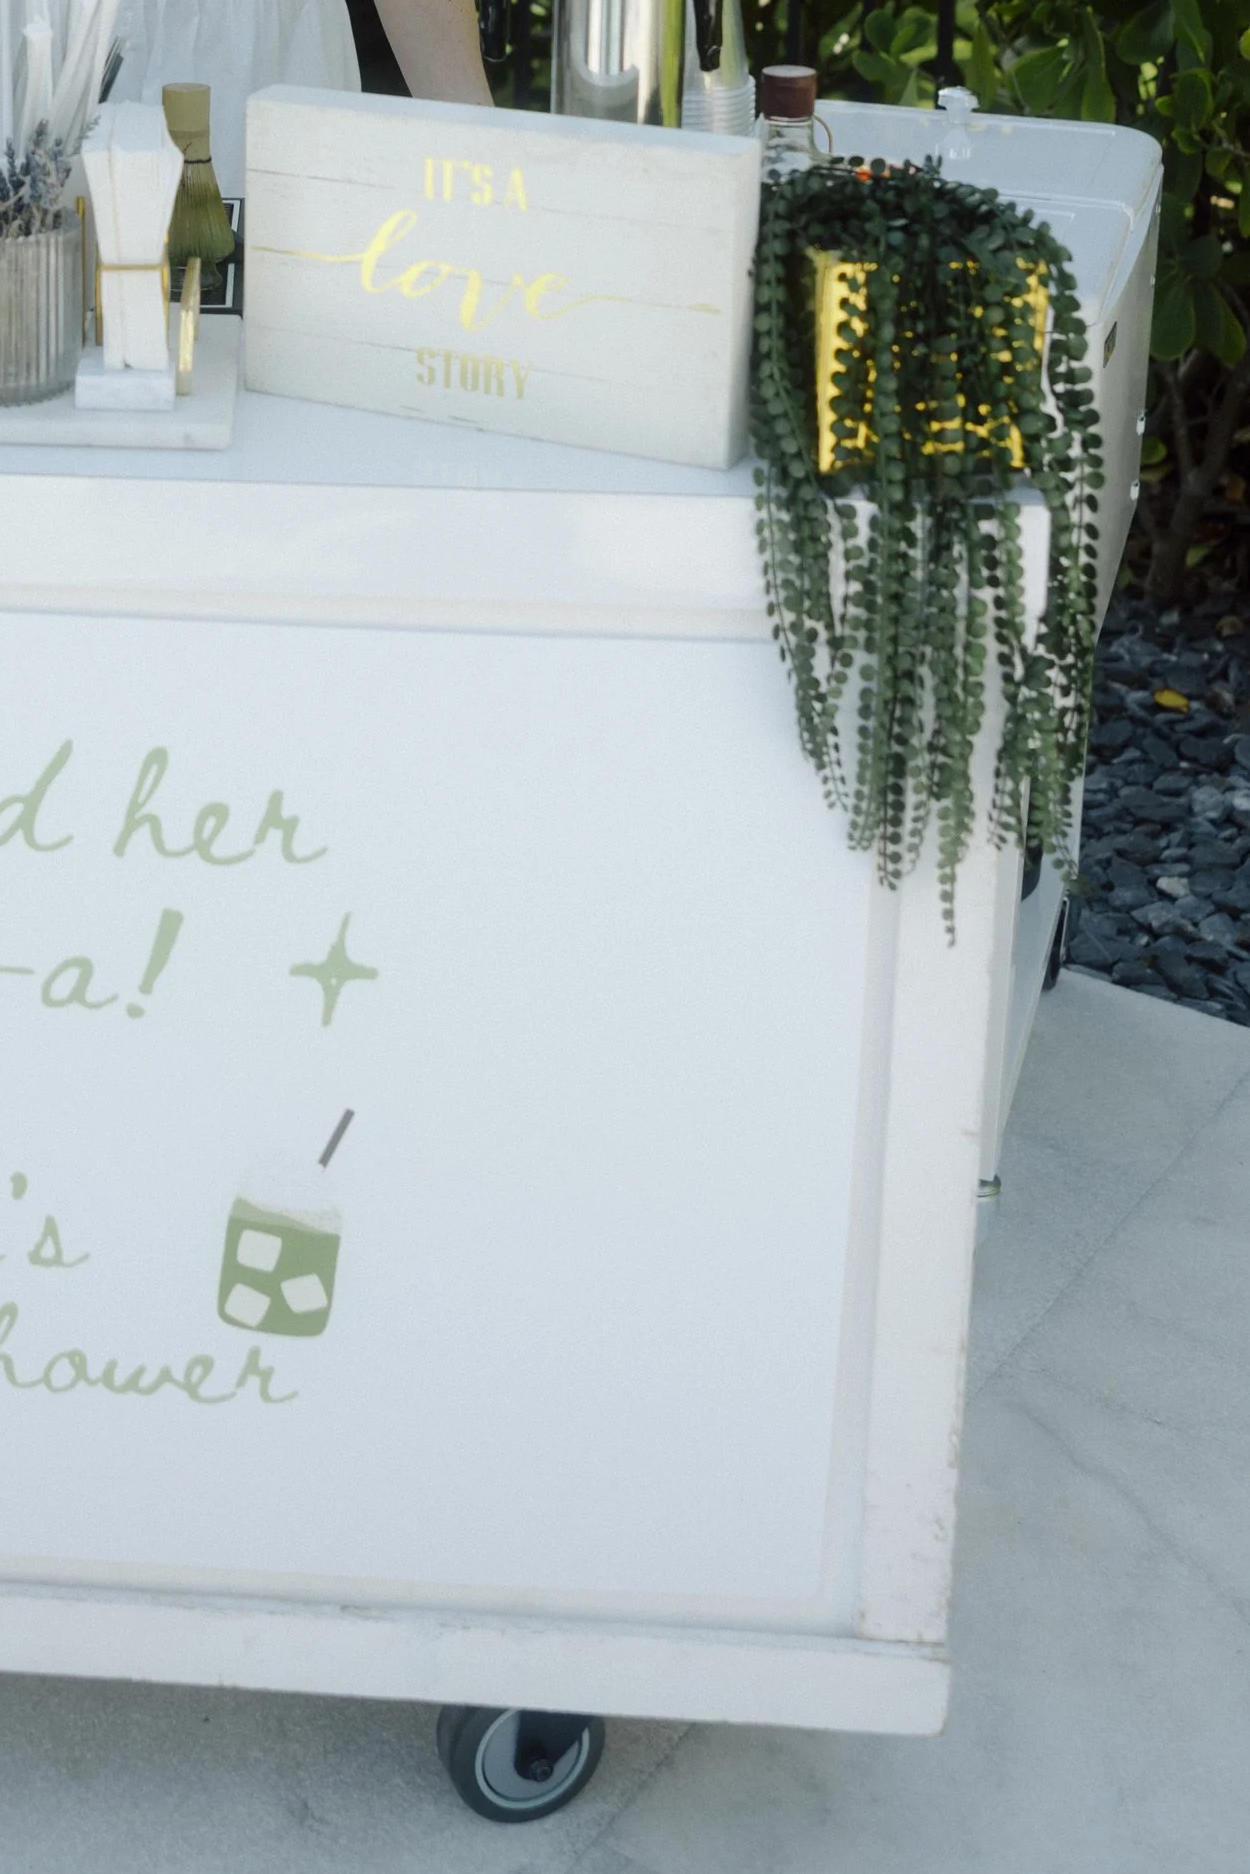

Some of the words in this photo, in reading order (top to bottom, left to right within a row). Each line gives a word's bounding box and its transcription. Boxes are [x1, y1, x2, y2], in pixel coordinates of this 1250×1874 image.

[423, 156, 494, 208] IT'S
[504, 168, 529, 212] A
[415, 346, 532, 400] STORY
[112, 746, 329, 866] her
